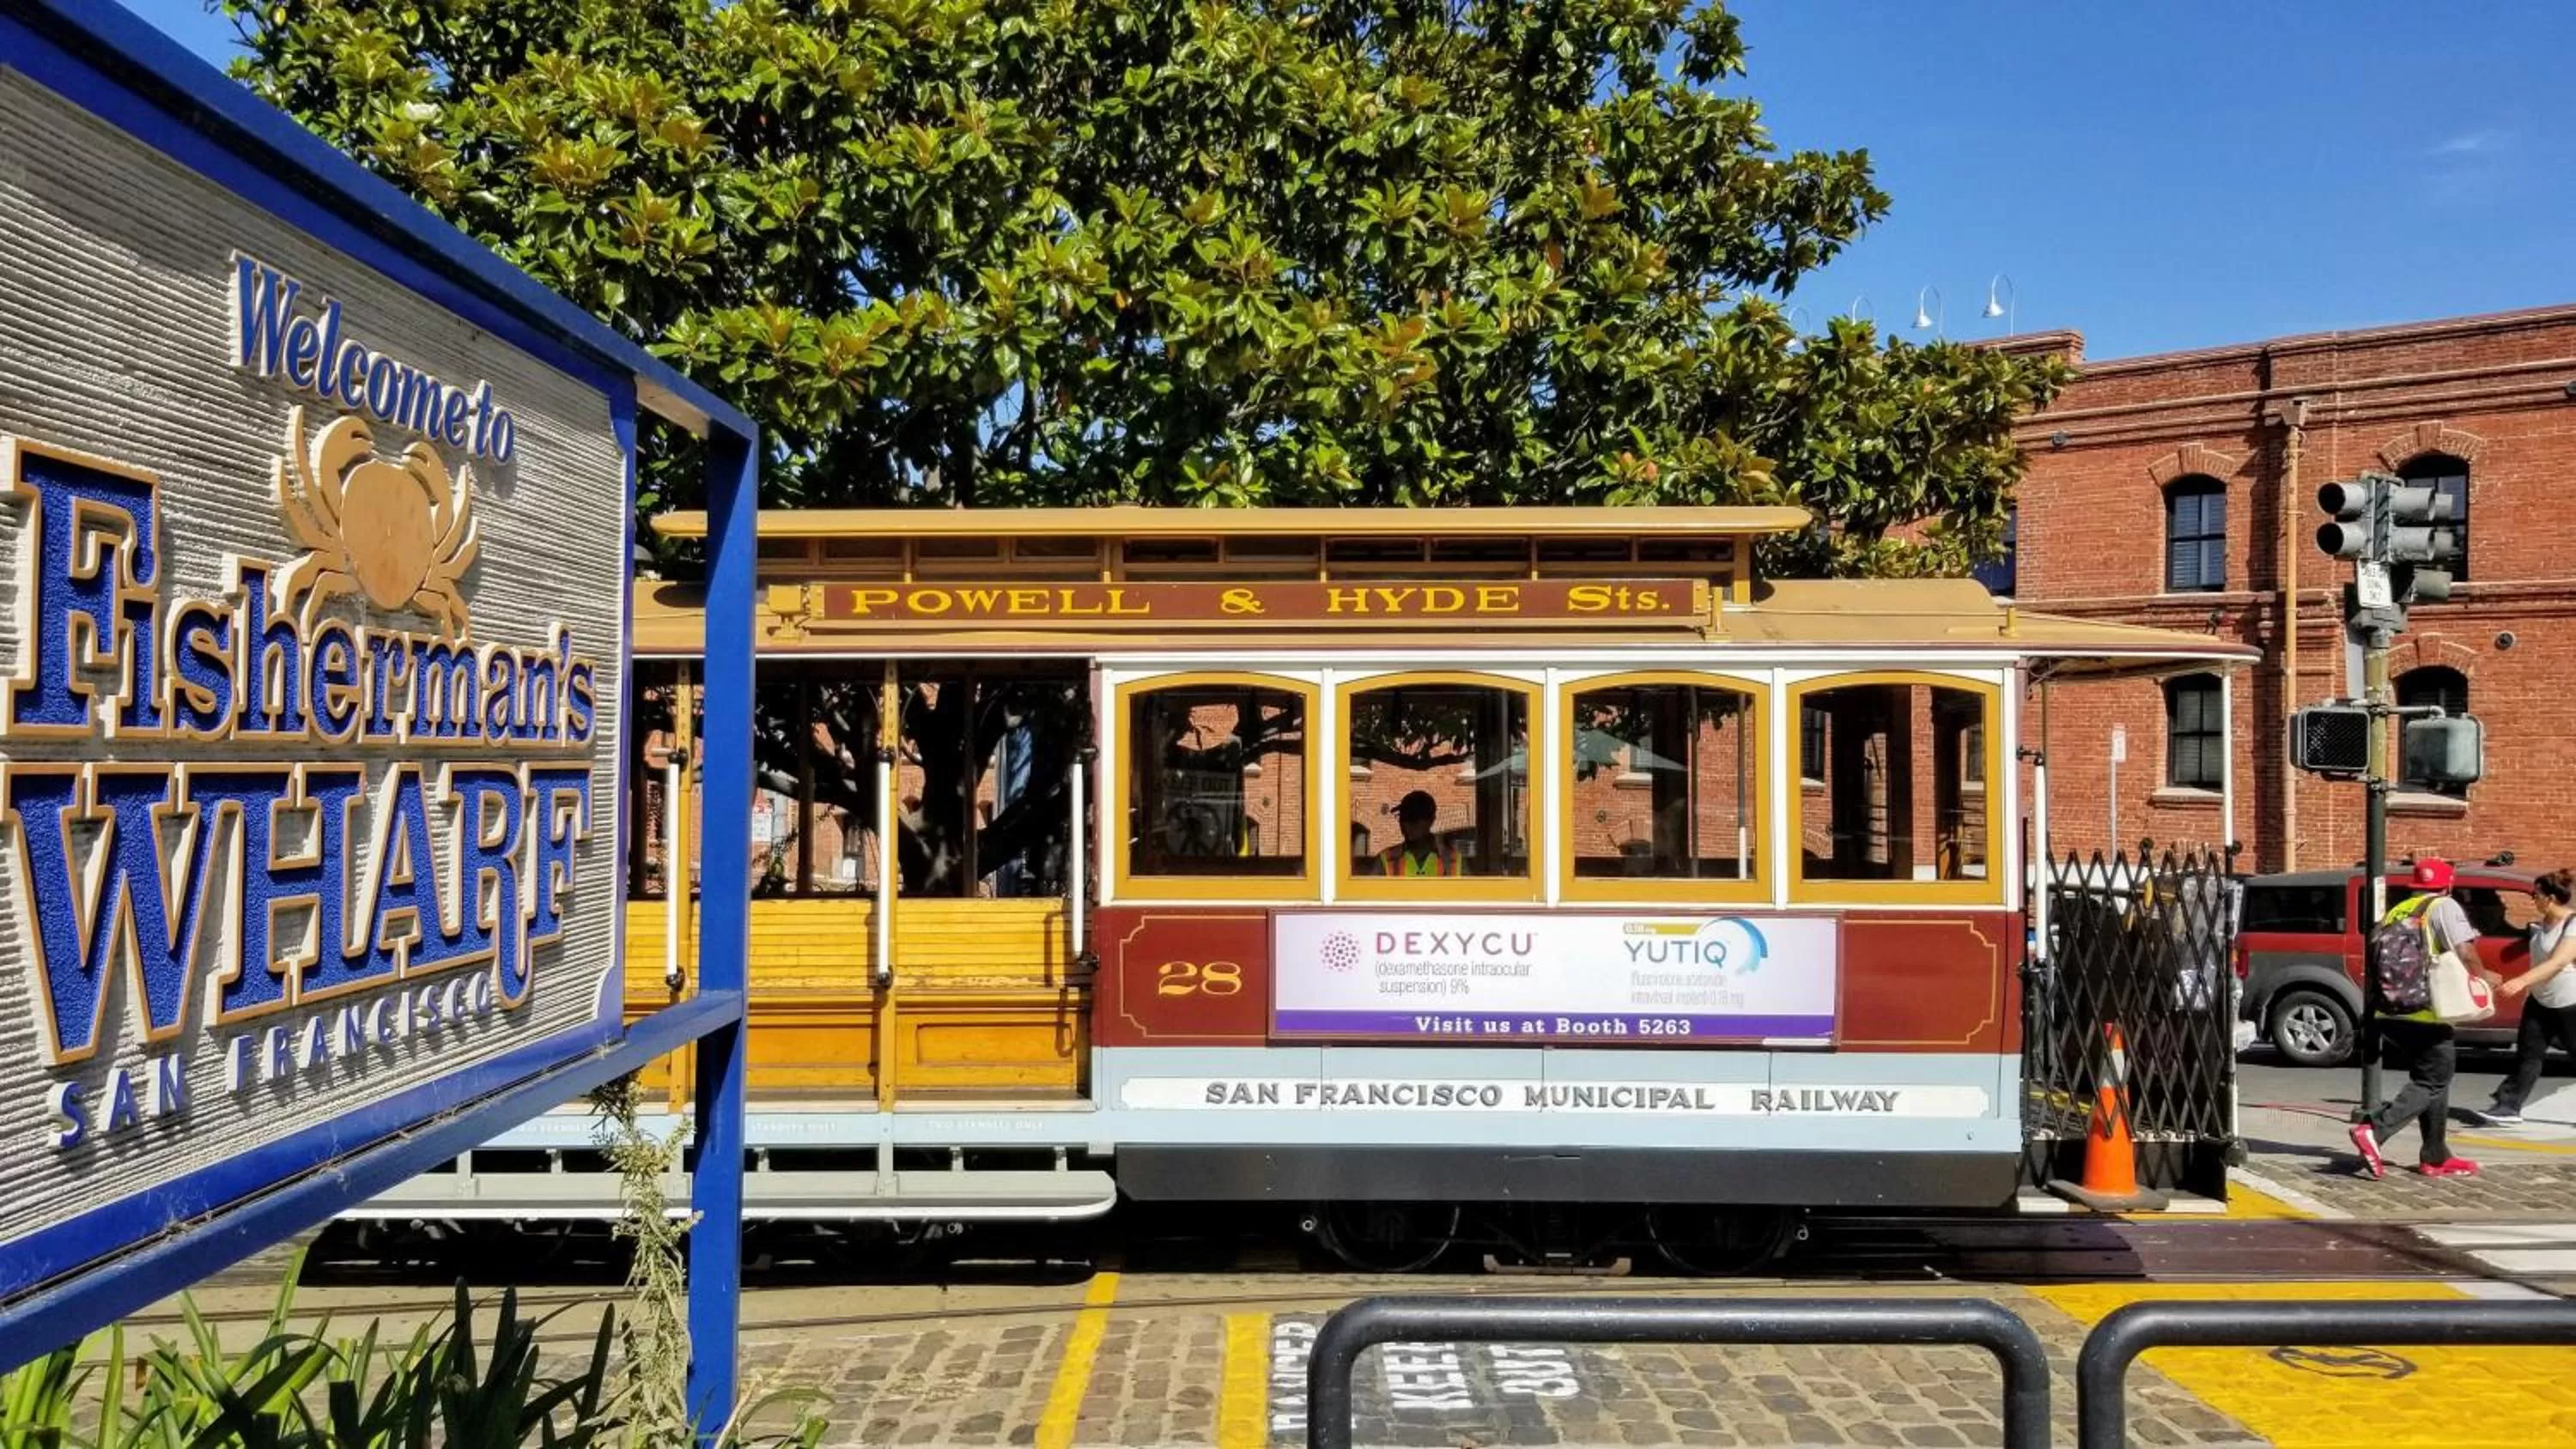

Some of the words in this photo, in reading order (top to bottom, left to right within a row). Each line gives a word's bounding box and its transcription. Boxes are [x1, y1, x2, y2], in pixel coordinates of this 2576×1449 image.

[234, 254, 469, 447] Welcome
[473, 379, 514, 464] to
[7, 440, 598, 748] Fisherman's
[851, 589, 1150, 615] POWELL
[1220, 588, 1265, 614] &
[1326, 586, 1520, 613] HYDE
[1568, 585, 1671, 612] Sts.
[3, 761, 593, 1064] WHARF
[1376, 931, 1533, 955] DEXYCU
[1623, 940, 1727, 968] YUTIQ
[1158, 961, 1242, 996] 28
[1375, 961, 1468, 977] (dexamethasone
[1378, 979, 1447, 996] suspension)
[1450, 979, 1470, 995] 9%
[1415, 1016, 1473, 1033] Visit
[1483, 1019, 1511, 1033] us
[1522, 1018, 1546, 1033] at
[1556, 1018, 1628, 1034] Booth
[1637, 1019, 1692, 1035] 5263
[52, 1054, 186, 1150] SAN
[227, 971, 493, 1094] FRANCISCO
[1205, 1082, 1280, 1106] SAN
[1294, 1082, 1503, 1107] FRANCISCO
[1523, 1085, 1716, 1110] MUNICIPAL
[1749, 1088, 1900, 1113] RAILWAY
